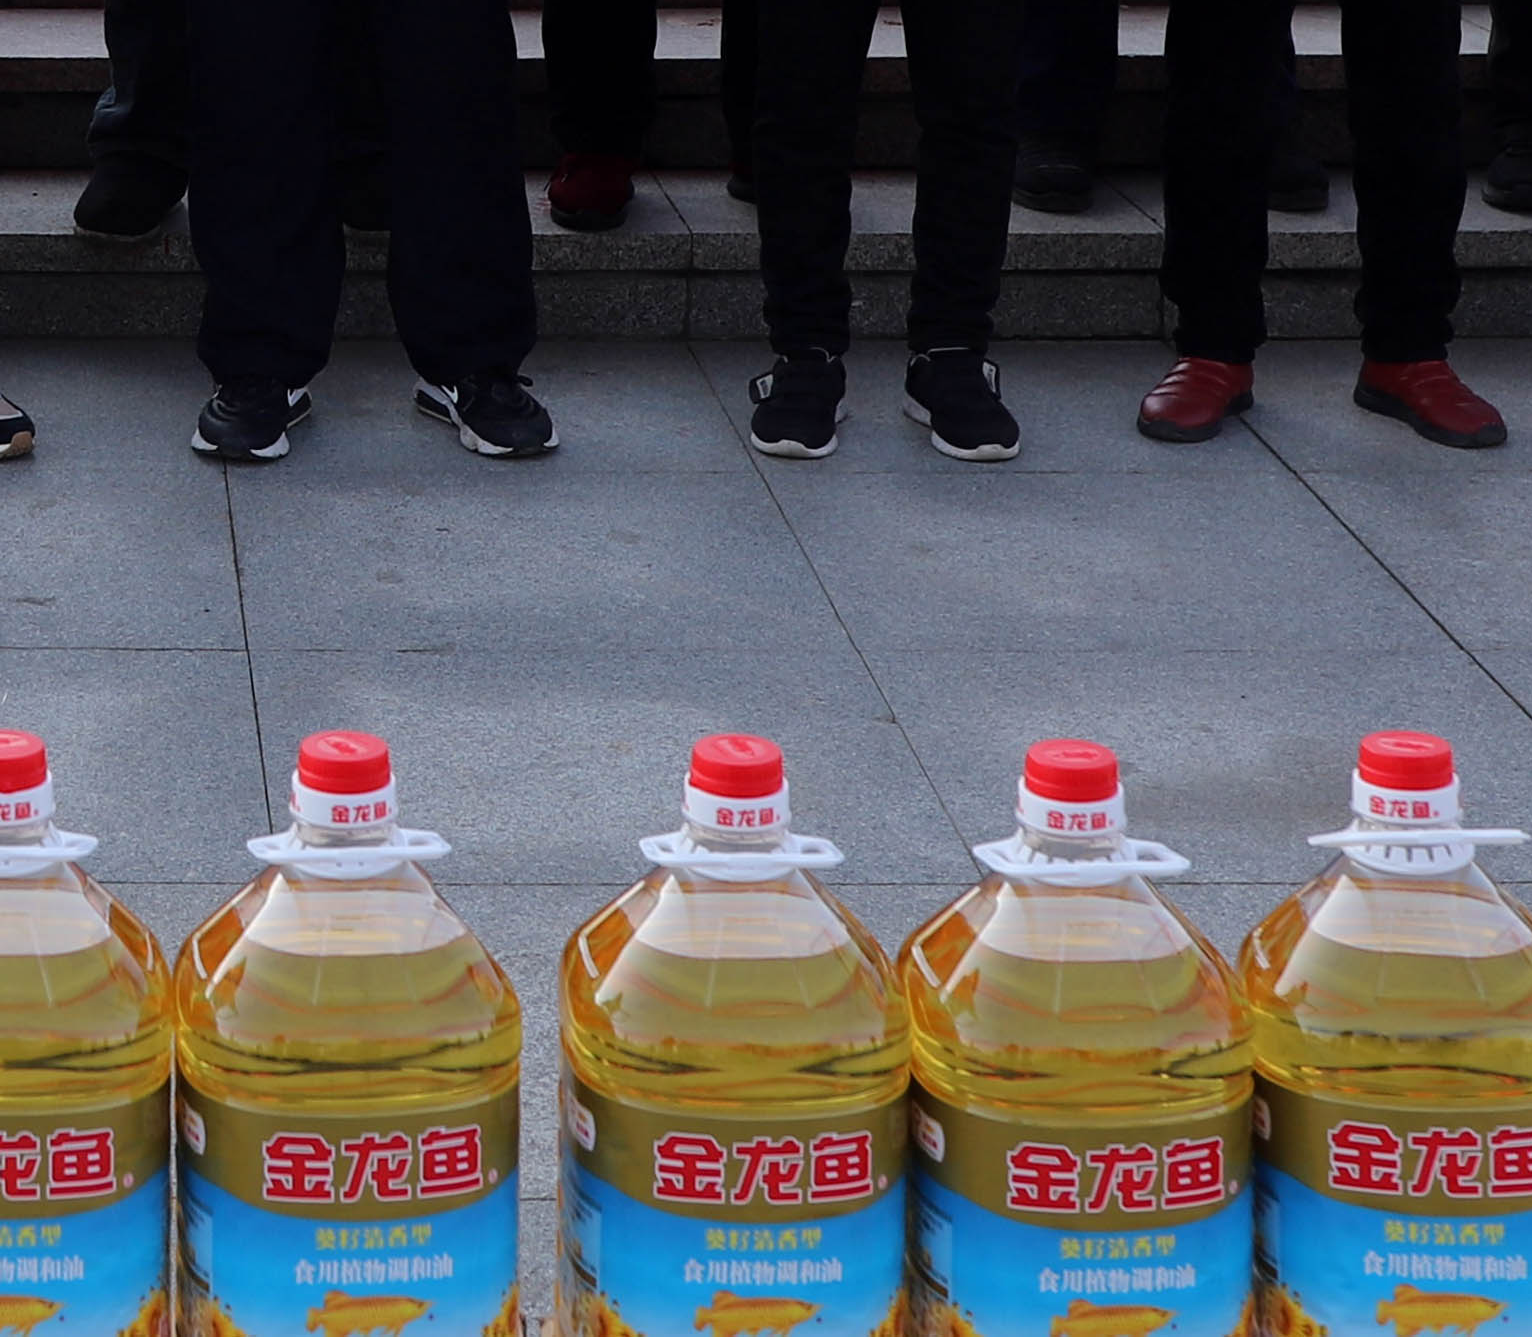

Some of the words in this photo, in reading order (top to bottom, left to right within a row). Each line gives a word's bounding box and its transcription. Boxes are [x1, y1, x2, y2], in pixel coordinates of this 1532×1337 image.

[330, 801, 388, 824] 金龙鱼
[715, 806, 775, 827] 金龙鱼
[1046, 809, 1109, 831] 金龙鱼
[1369, 795, 1432, 820] 金龙鱼
[263, 1125, 484, 1203] 金龙鱼
[653, 1132, 874, 1205] 金龙鱼
[1007, 1138, 1225, 1213] 金龙鱼
[292, 1255, 454, 1285] 食用植物调和油
[683, 1256, 844, 1286] 食用植物调和油
[1037, 1263, 1197, 1293] 食用植物调和油
[1362, 1252, 1529, 1282] 食用植物调和油
